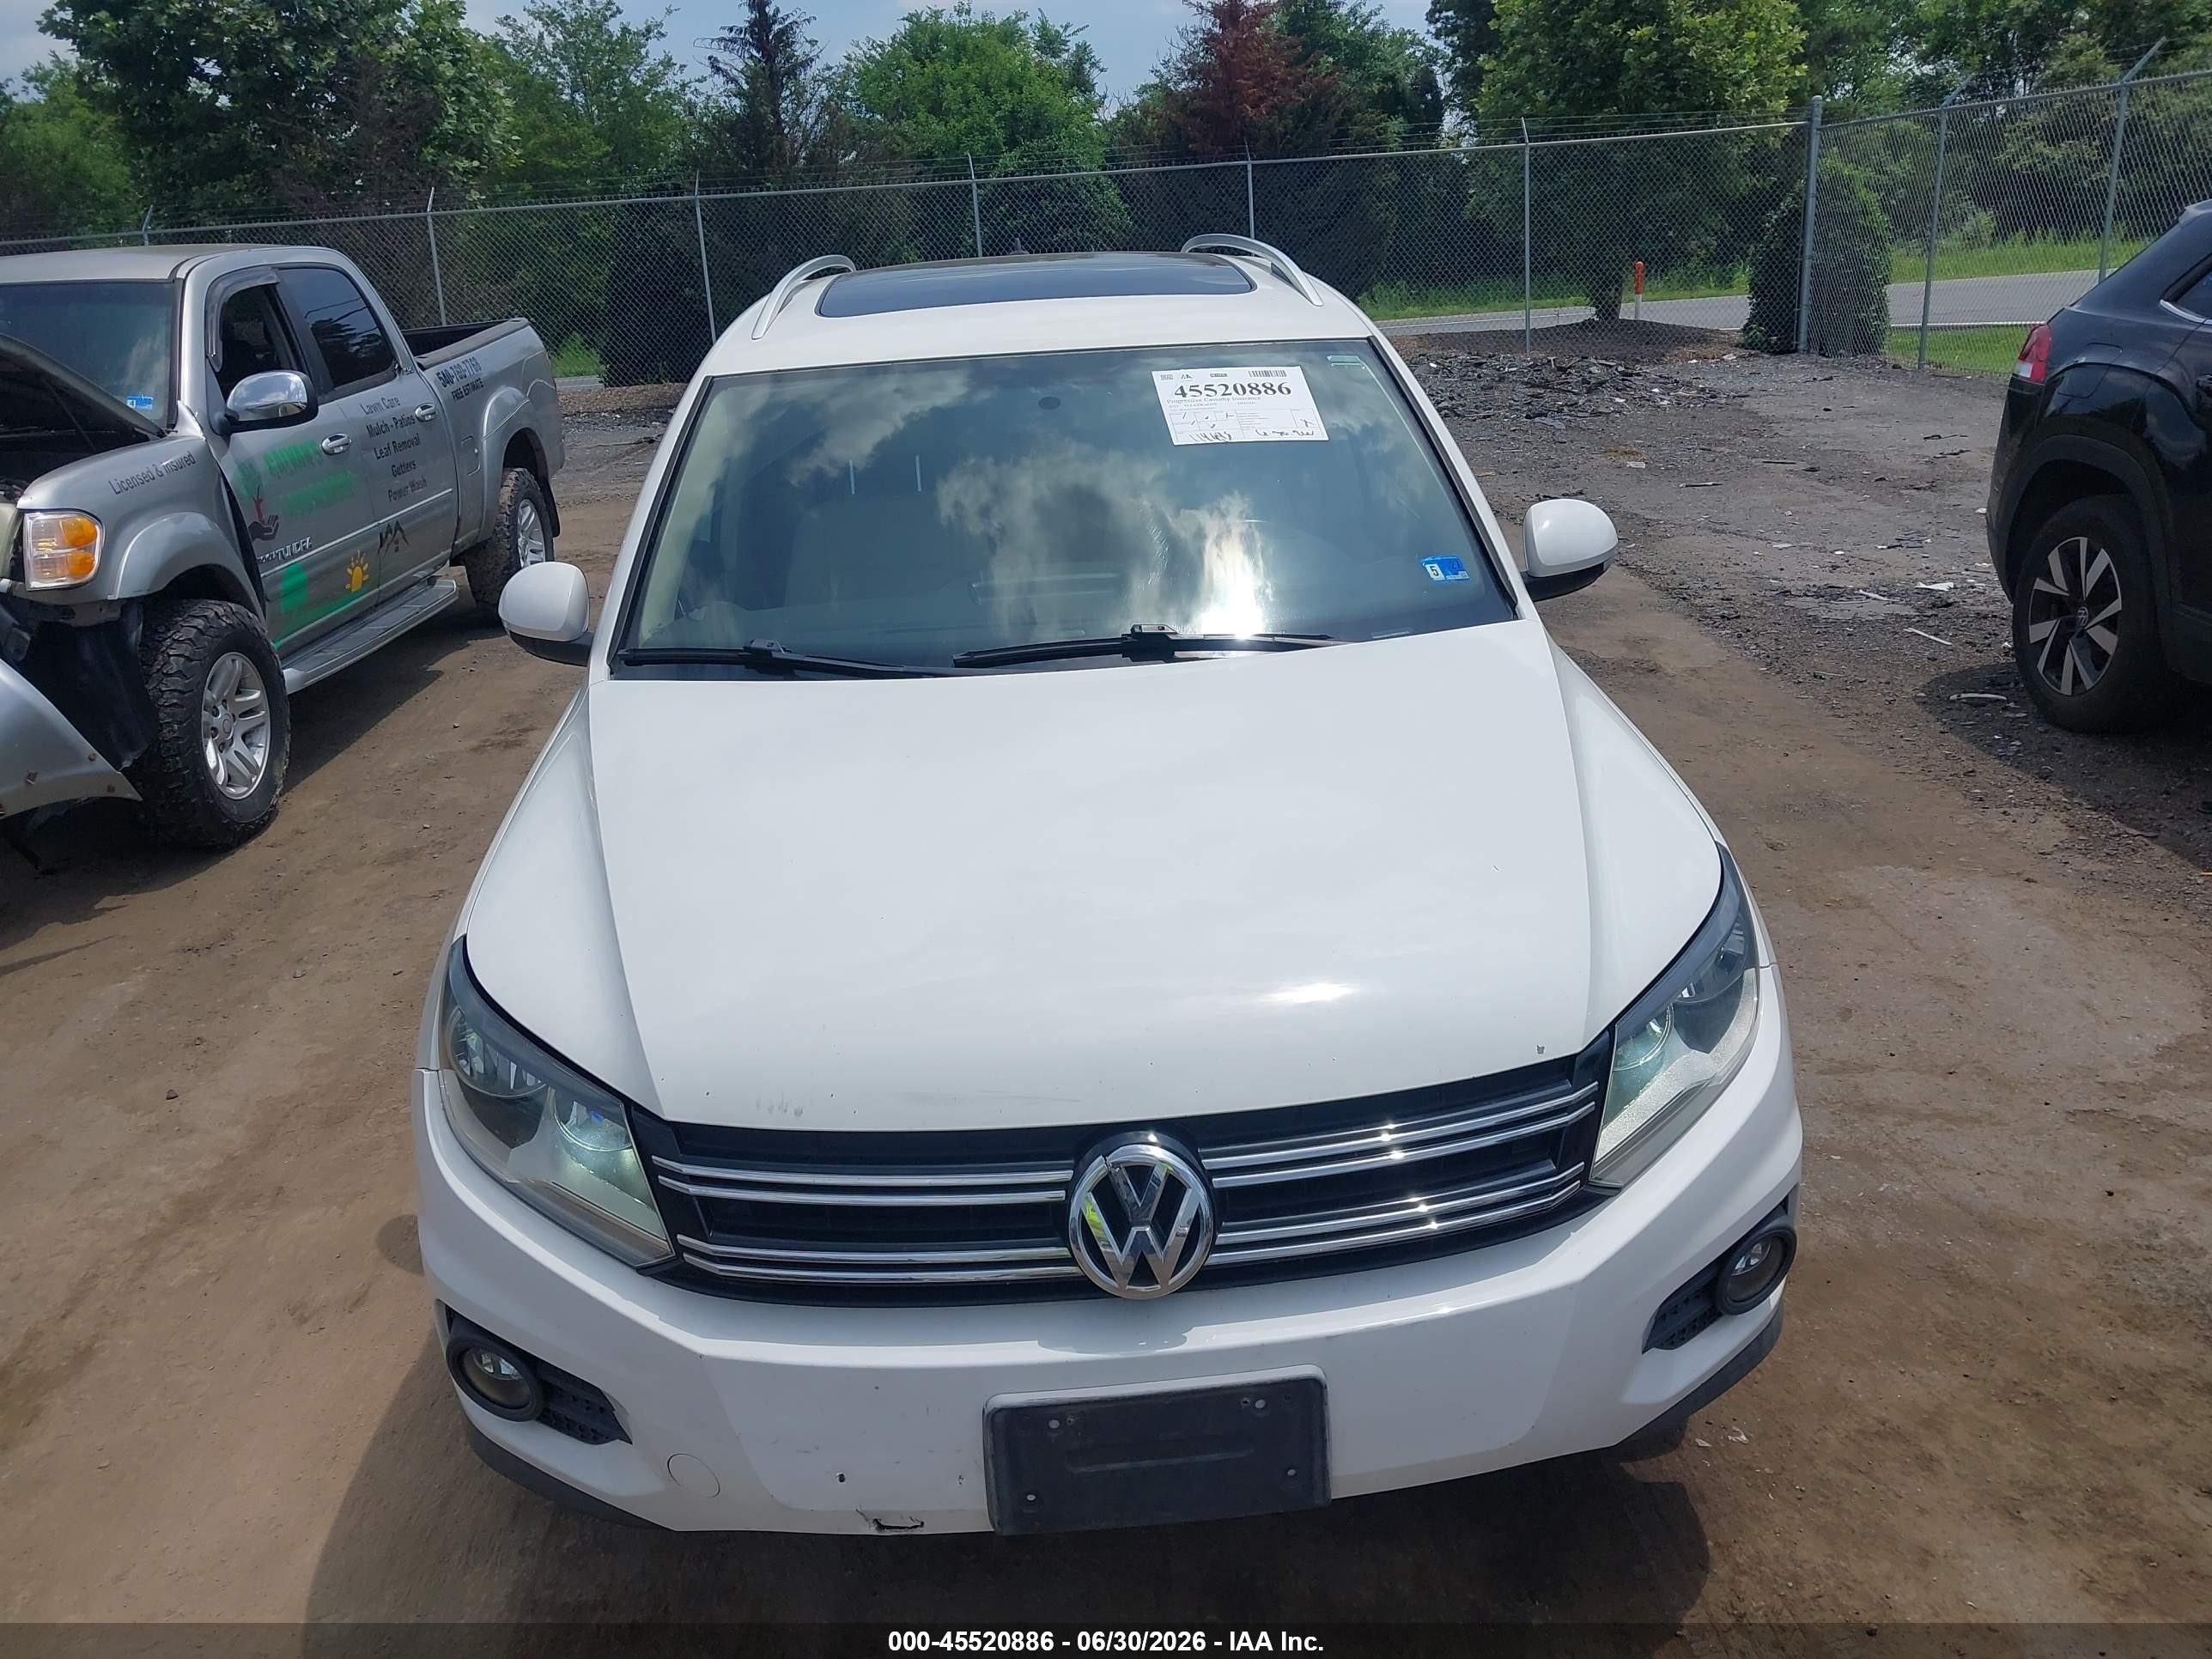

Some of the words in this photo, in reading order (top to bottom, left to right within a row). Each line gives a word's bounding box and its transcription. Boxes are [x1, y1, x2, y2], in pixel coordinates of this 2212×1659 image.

[451, 387, 465, 401] FREE
[1175, 382, 1291, 398] 45520886
[359, 402, 384, 415] Lawn
[380, 397, 401, 410] Care
[366, 420, 390, 439] Mulch
[392, 413, 416, 429] Patios
[374, 442, 392, 460] Leaf
[392, 432, 421, 454] Removal
[108, 464, 155, 495] Licensed
[155, 467, 164, 477] &
[1430, 565, 1439, 576] 5
